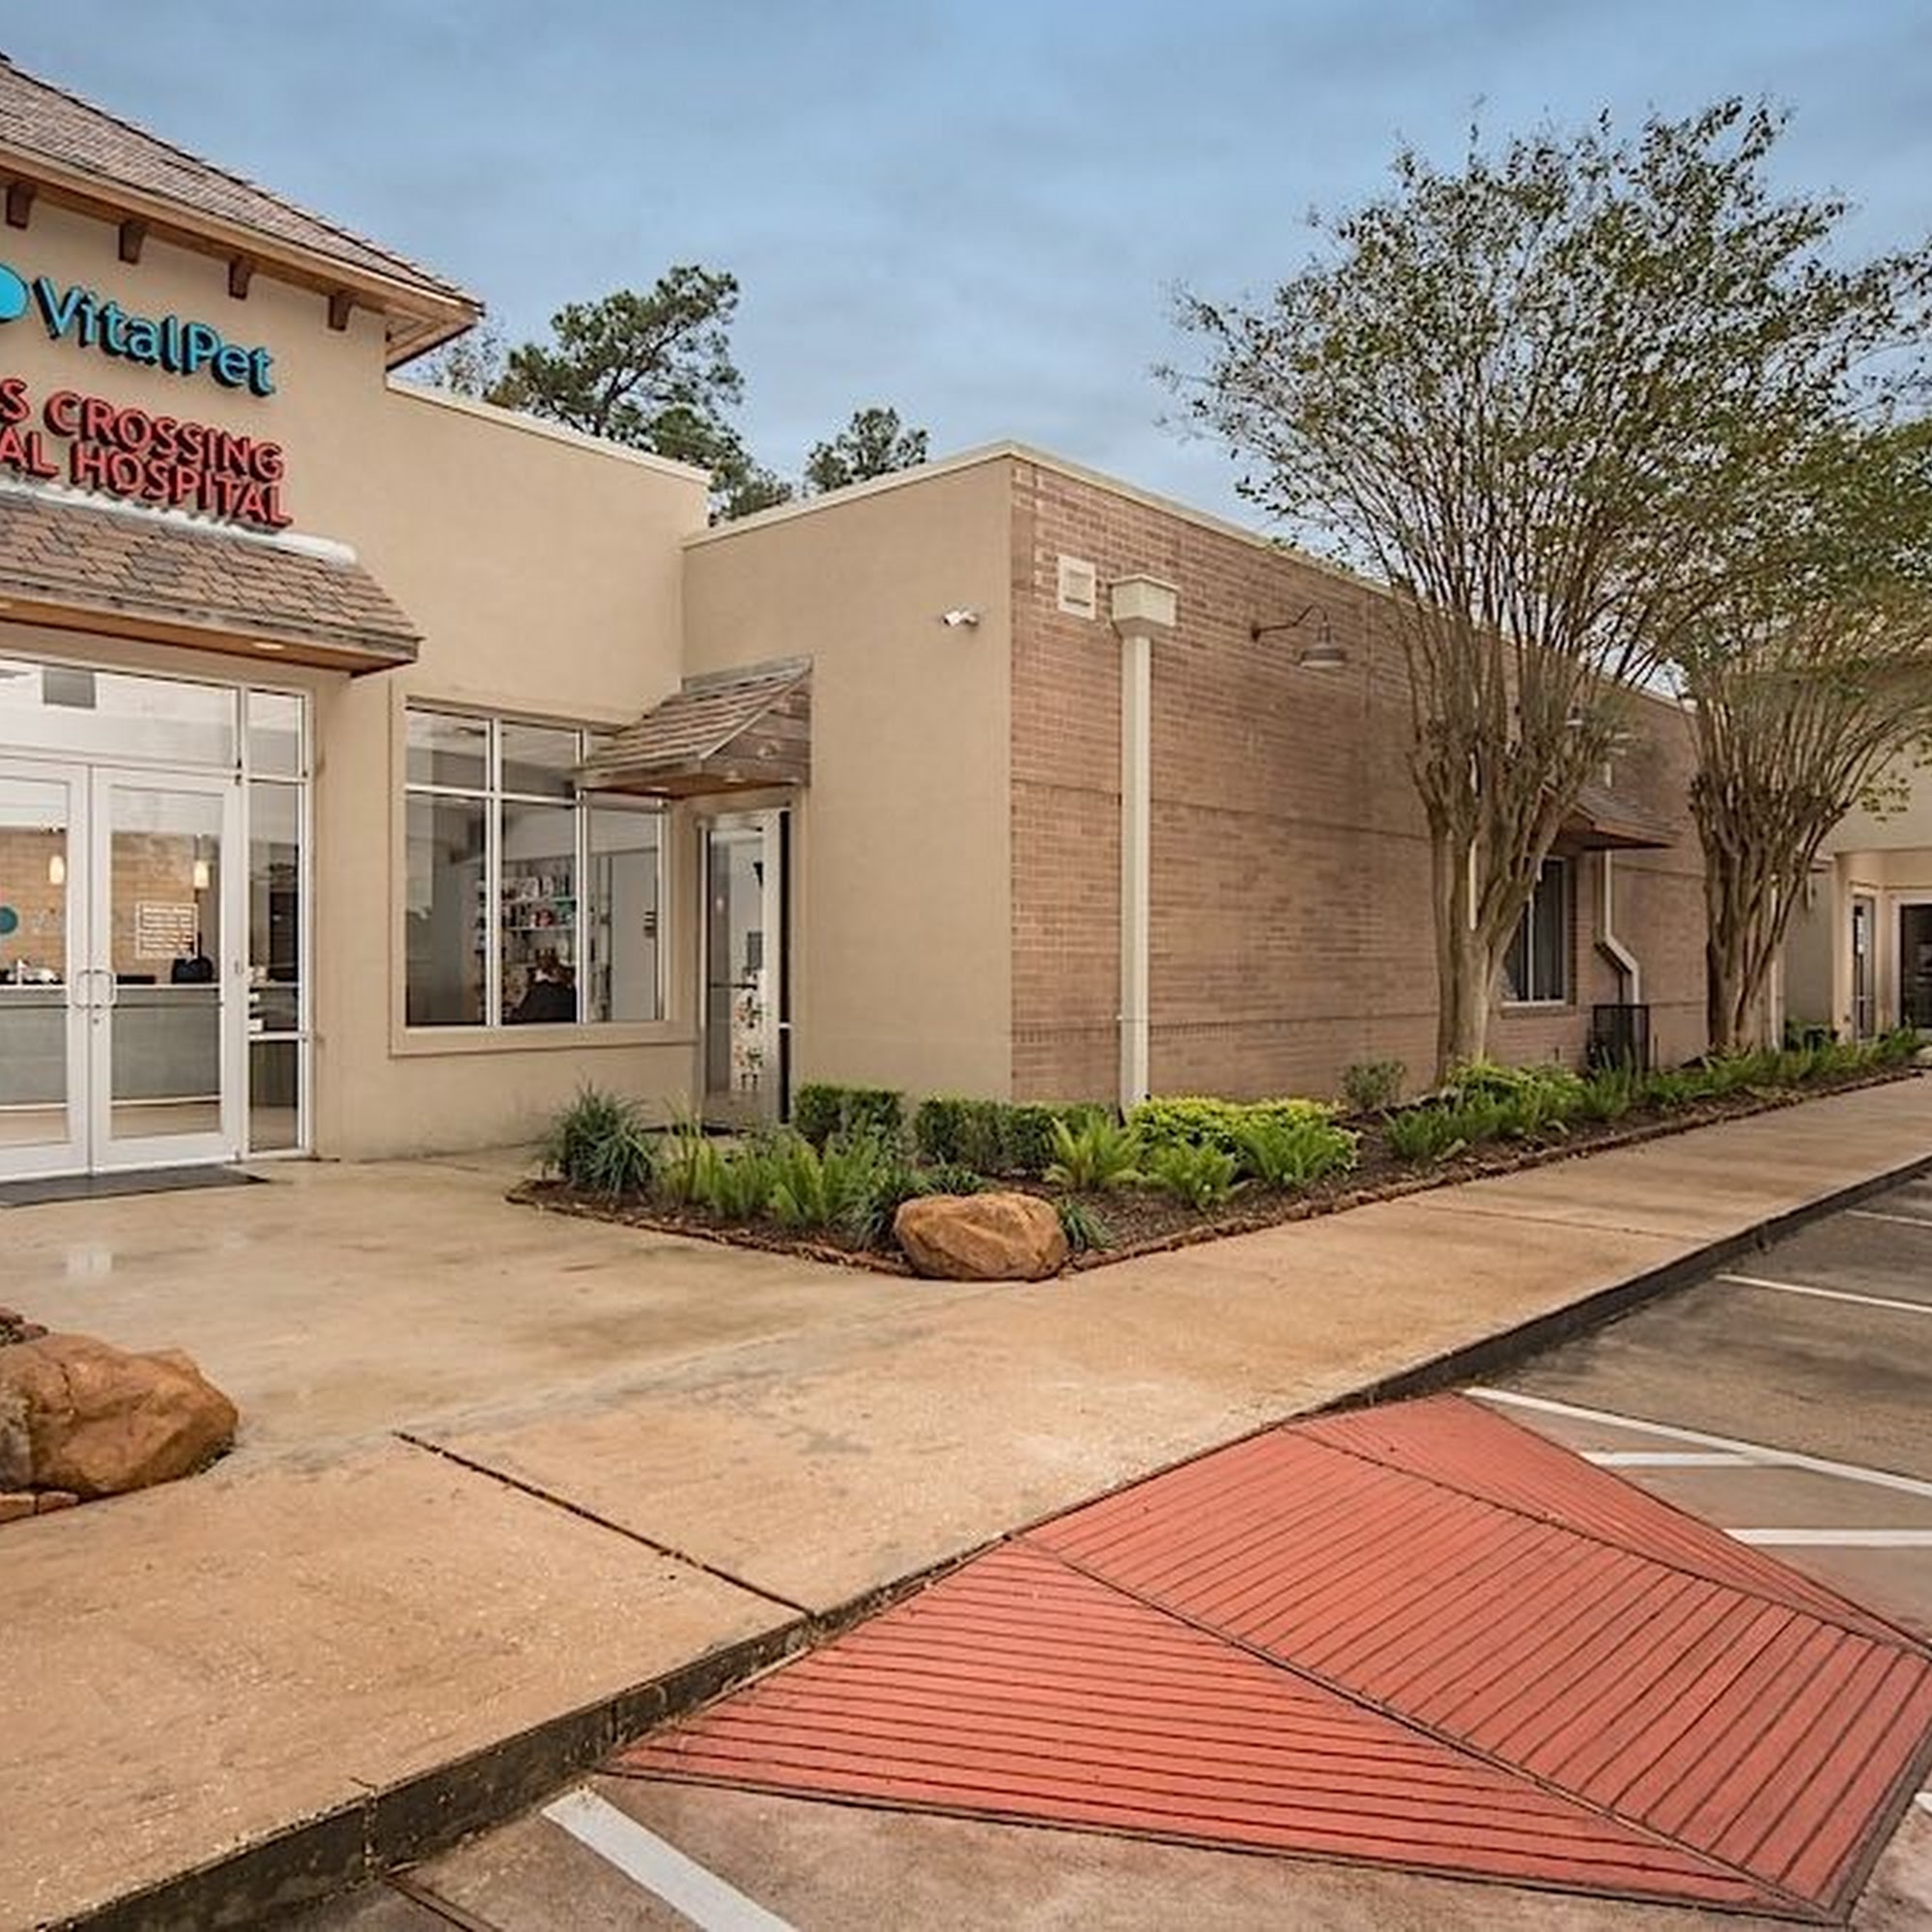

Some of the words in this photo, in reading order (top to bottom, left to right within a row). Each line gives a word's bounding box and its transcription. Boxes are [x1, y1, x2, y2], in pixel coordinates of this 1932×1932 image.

[32, 276, 274, 395] VitalPet
[44, 391, 283, 482] CROSSING
[71, 441, 293, 527] HOSPITAL
